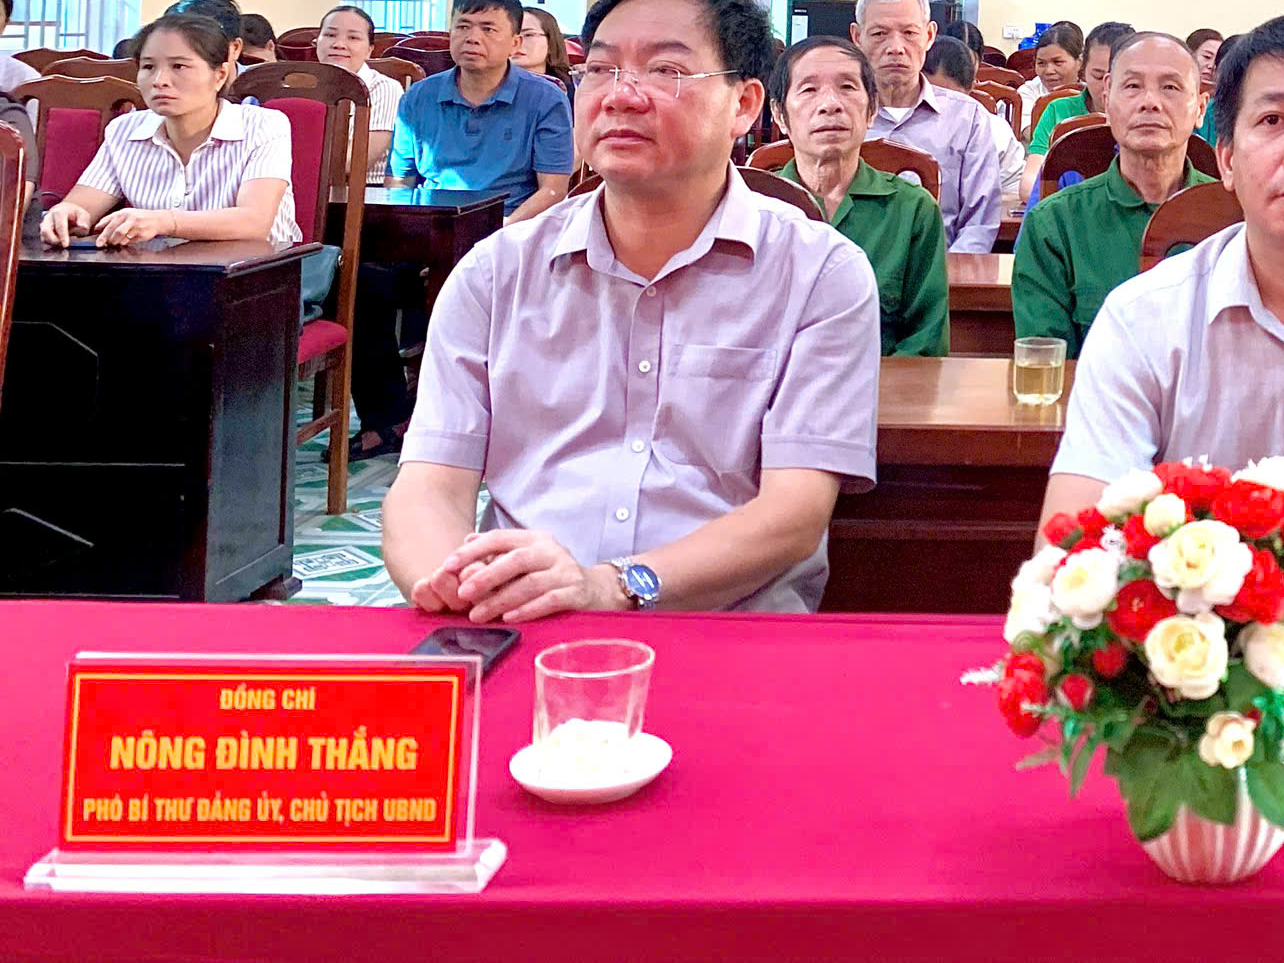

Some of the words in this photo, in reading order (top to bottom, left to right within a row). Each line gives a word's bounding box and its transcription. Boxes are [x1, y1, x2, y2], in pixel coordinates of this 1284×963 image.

[281, 685, 317, 710] CHÍ
[109, 729, 206, 771] NÔNG
[215, 730, 298, 771] ĐÌNH
[128, 792, 149, 822] BÍ
[154, 796, 195, 822] THƯ
[334, 797, 379, 827] TỊCH
[382, 797, 437, 822] UBND
